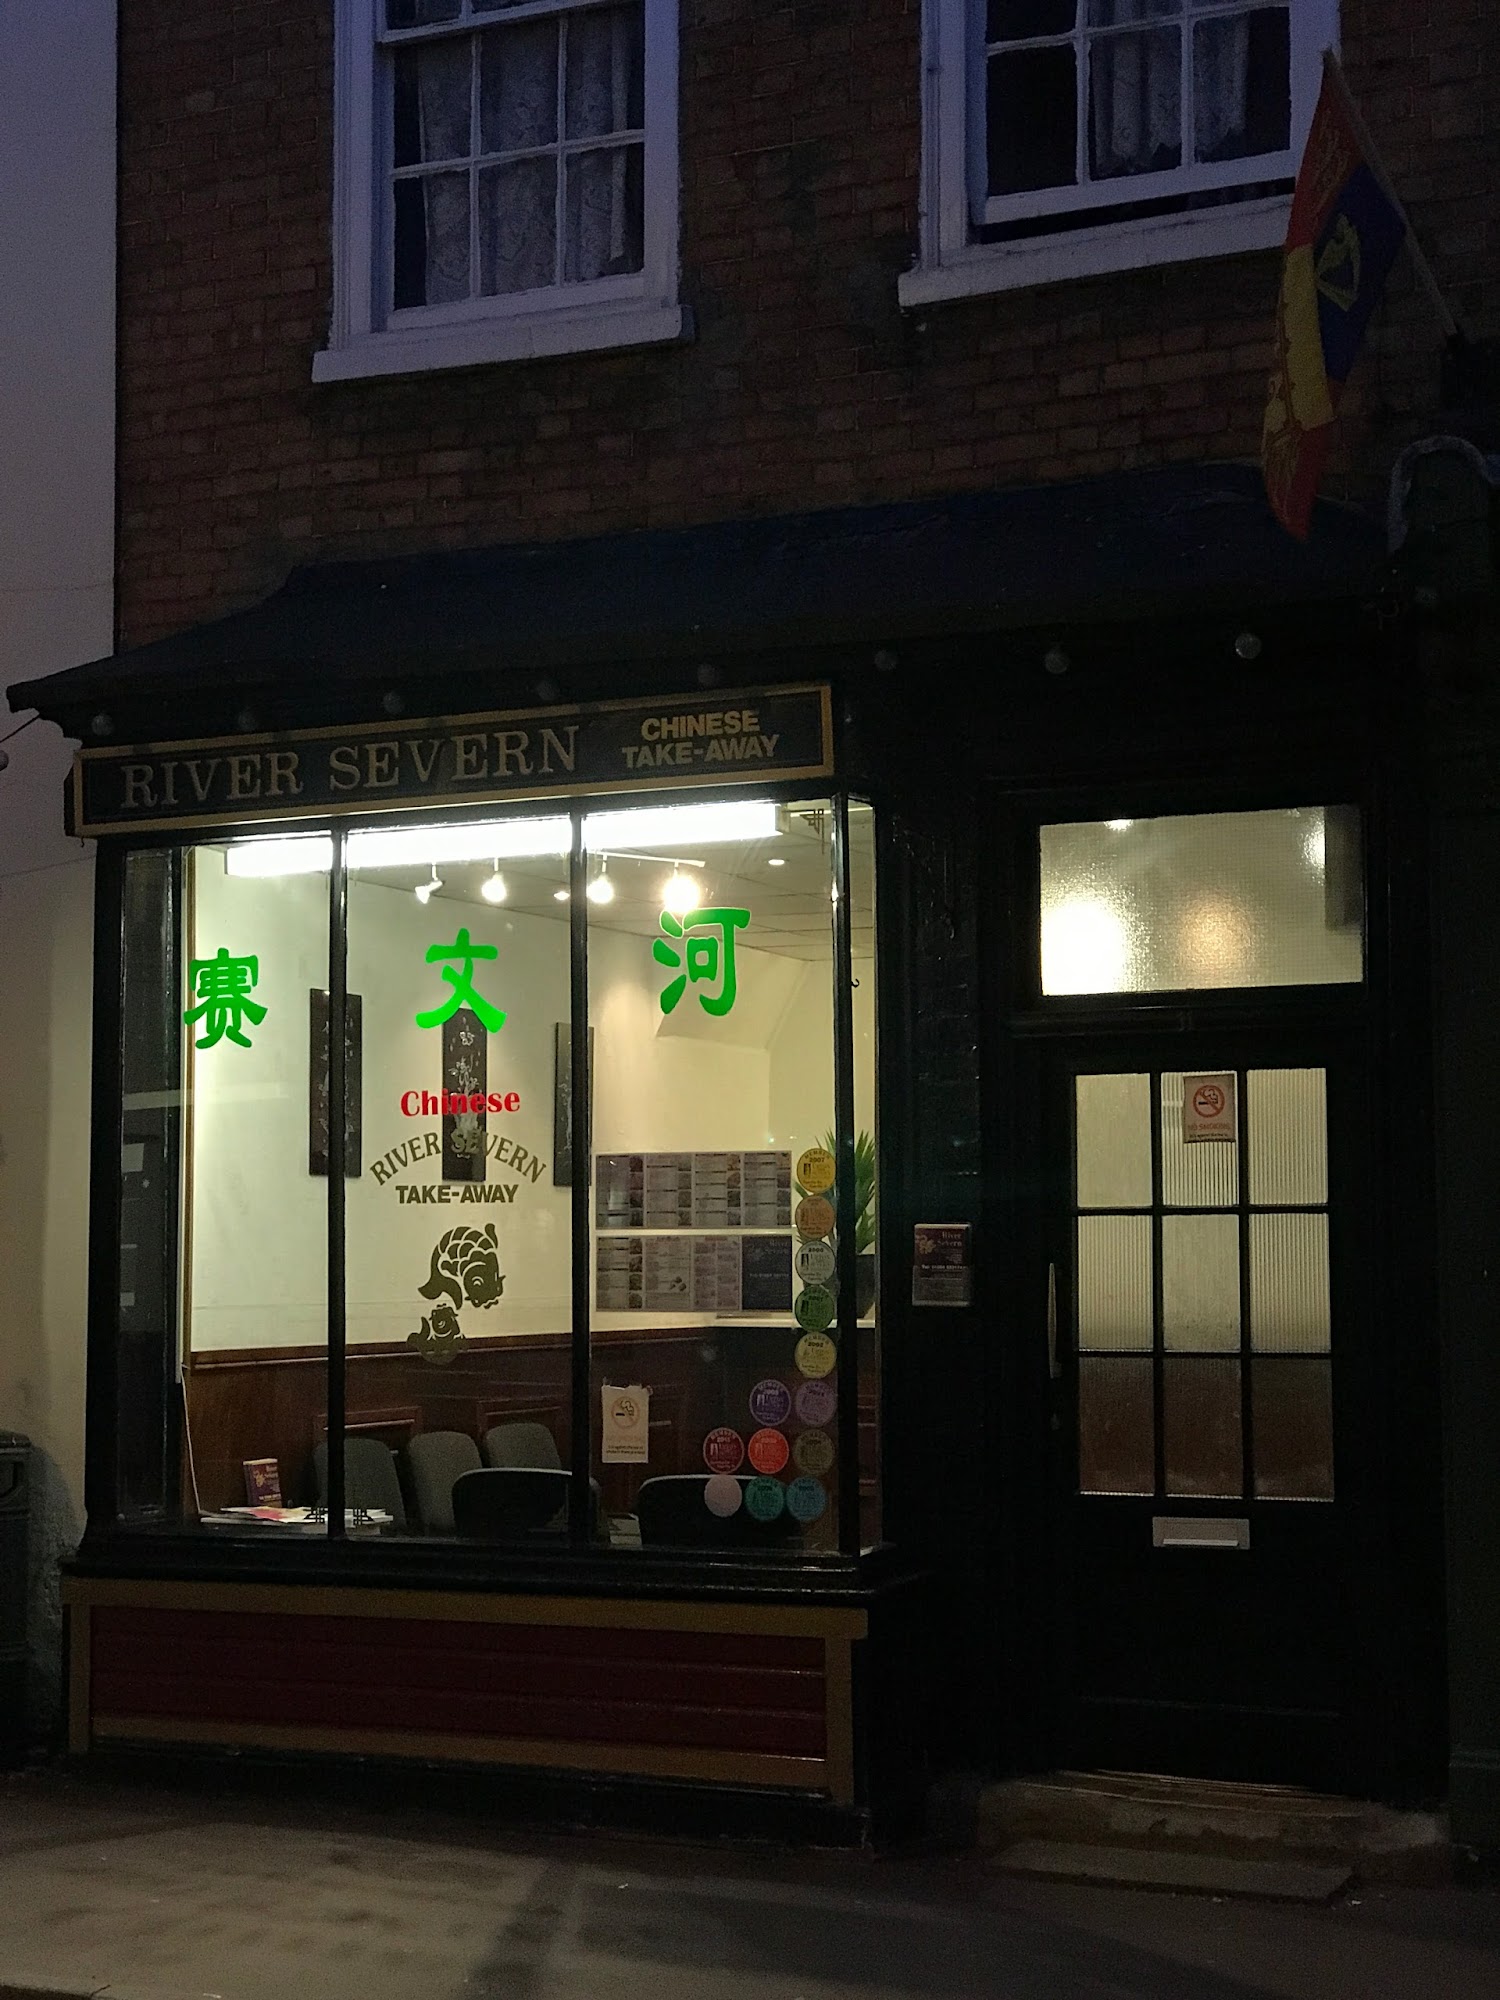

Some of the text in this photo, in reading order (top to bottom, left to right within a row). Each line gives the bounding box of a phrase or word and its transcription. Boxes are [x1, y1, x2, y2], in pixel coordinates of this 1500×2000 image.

[641, 710, 761, 742] CHINESE
[120, 725, 580, 808] RIVER SEVERN
[622, 734, 780, 769] TAKE-AWAY
[400, 1087, 521, 1117] Chinese
[369, 1127, 547, 1186] RIVER SEVERN
[395, 1184, 519, 1204] TAKE-AWAY
